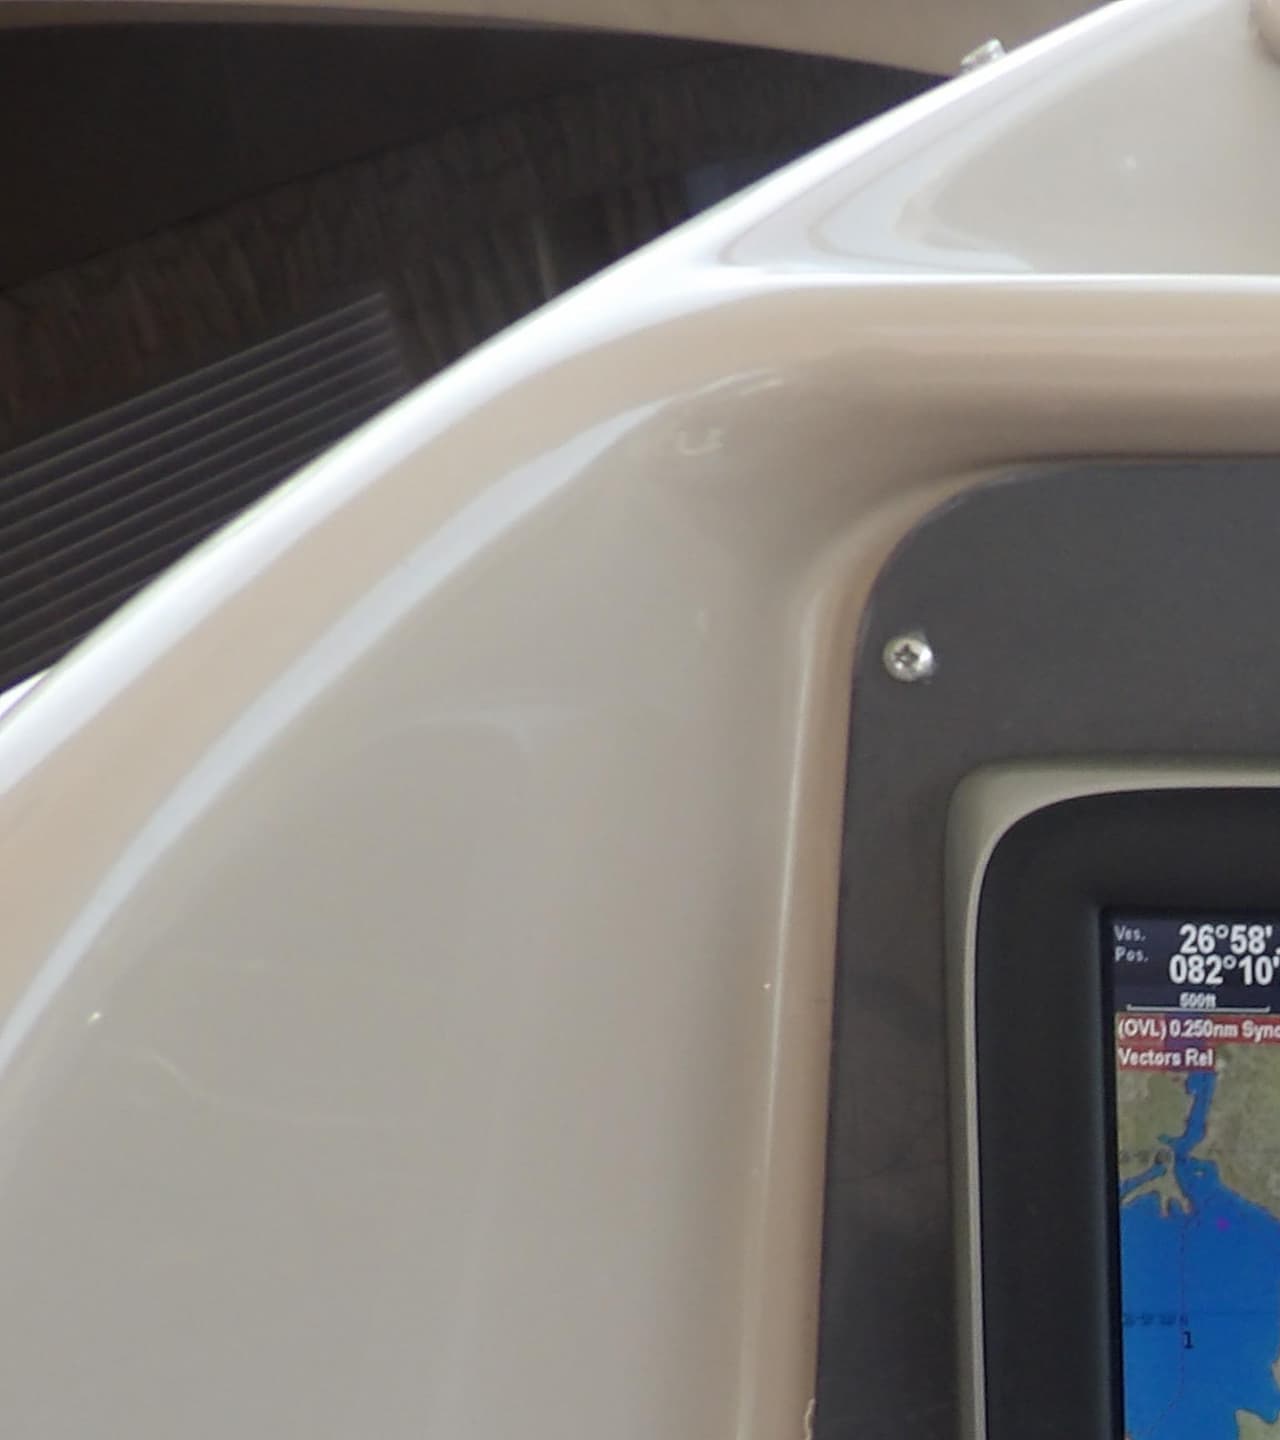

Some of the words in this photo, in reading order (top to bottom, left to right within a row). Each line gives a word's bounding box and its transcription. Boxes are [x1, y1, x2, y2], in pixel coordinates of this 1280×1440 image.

[1114, 947, 1149, 963] Pos.
[1117, 1018, 1167, 1041] (OVL)
[1169, 1019, 1238, 1039] 0.250nm
[1117, 1048, 1181, 1067] Vectors
[1185, 1048, 1215, 1067] Rel
